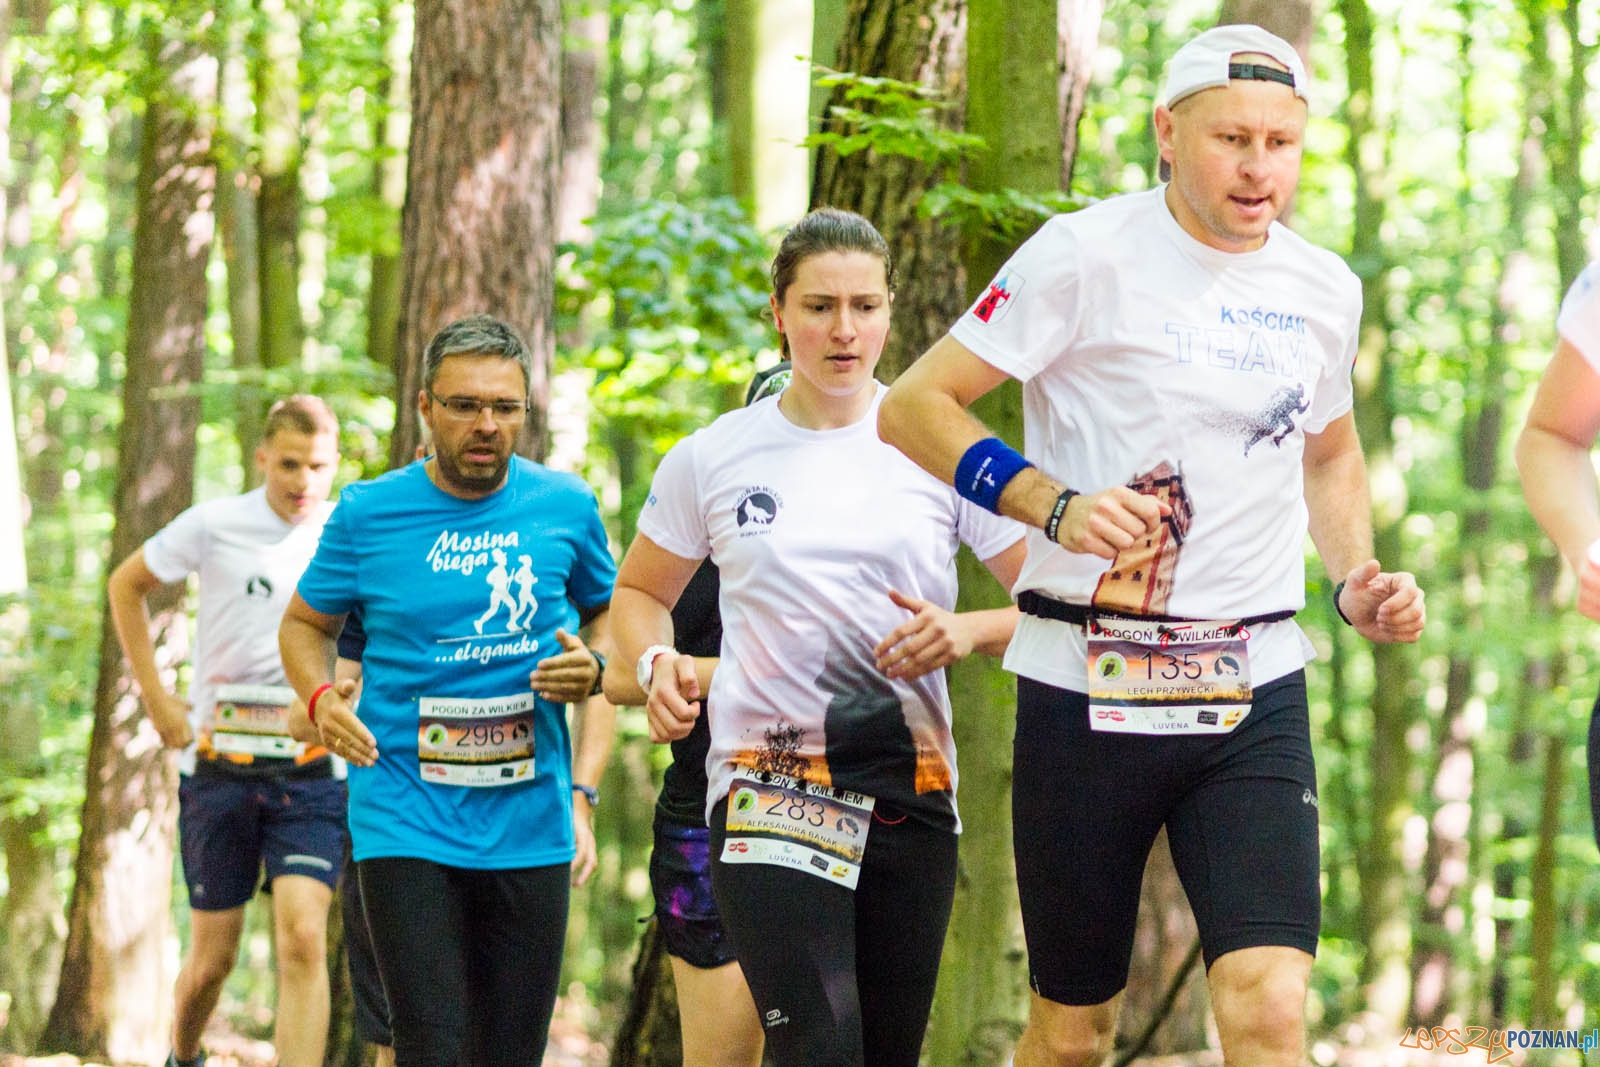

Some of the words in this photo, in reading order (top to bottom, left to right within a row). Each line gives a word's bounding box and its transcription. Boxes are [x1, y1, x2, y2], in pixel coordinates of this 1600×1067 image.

[1221, 305, 1305, 335] KOŚCIAN
[1165, 322, 1311, 382] TEAM
[432, 550, 488, 576] biega
[1141, 650, 1202, 681] 135
[1127, 687, 1153, 696] LECH
[1156, 686, 1214, 695] PRZYWECKI
[472, 706, 486, 715] ZA
[456, 722, 505, 746] 296
[766, 790, 825, 827] 283
[747, 819, 806, 836] ALEKSANDRA
[769, 854, 803, 866] LUVENA
